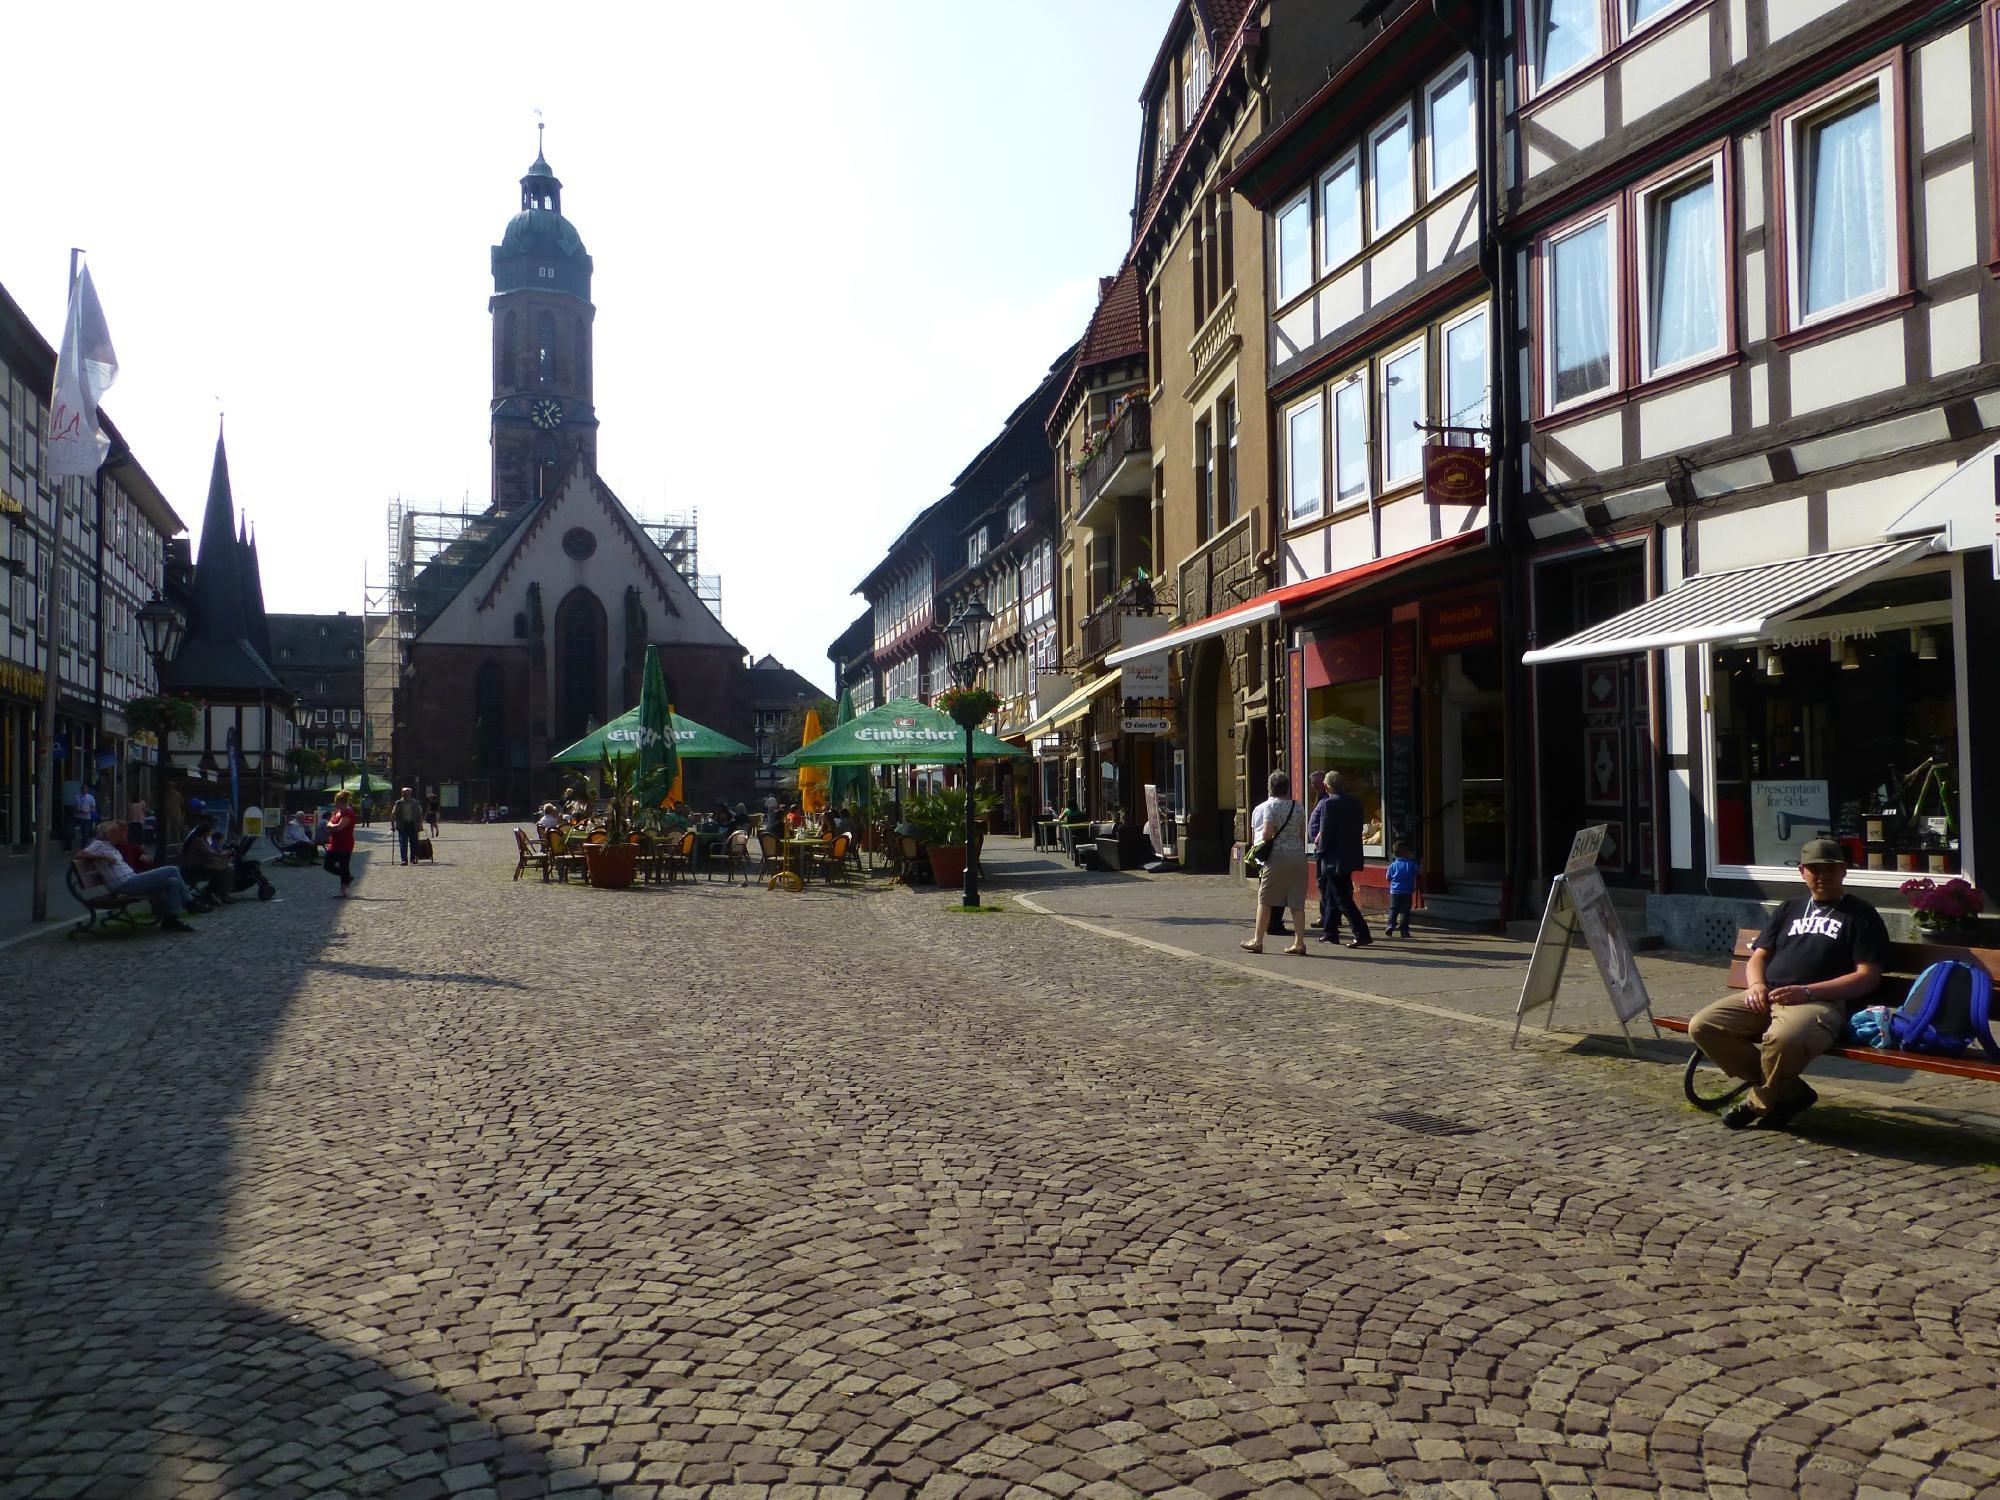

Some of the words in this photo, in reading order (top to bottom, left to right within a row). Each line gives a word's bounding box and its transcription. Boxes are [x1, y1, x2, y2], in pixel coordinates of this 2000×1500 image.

[1439, 604, 1481, 623] Herzlich
[1431, 627, 1493, 648] Willkommen
[1771, 624, 1877, 650] SPORT-OPTIK
[1756, 783, 1821, 797] Prescription
[1767, 795, 1782, 807] for
[1787, 916, 1842, 940] NIKE
